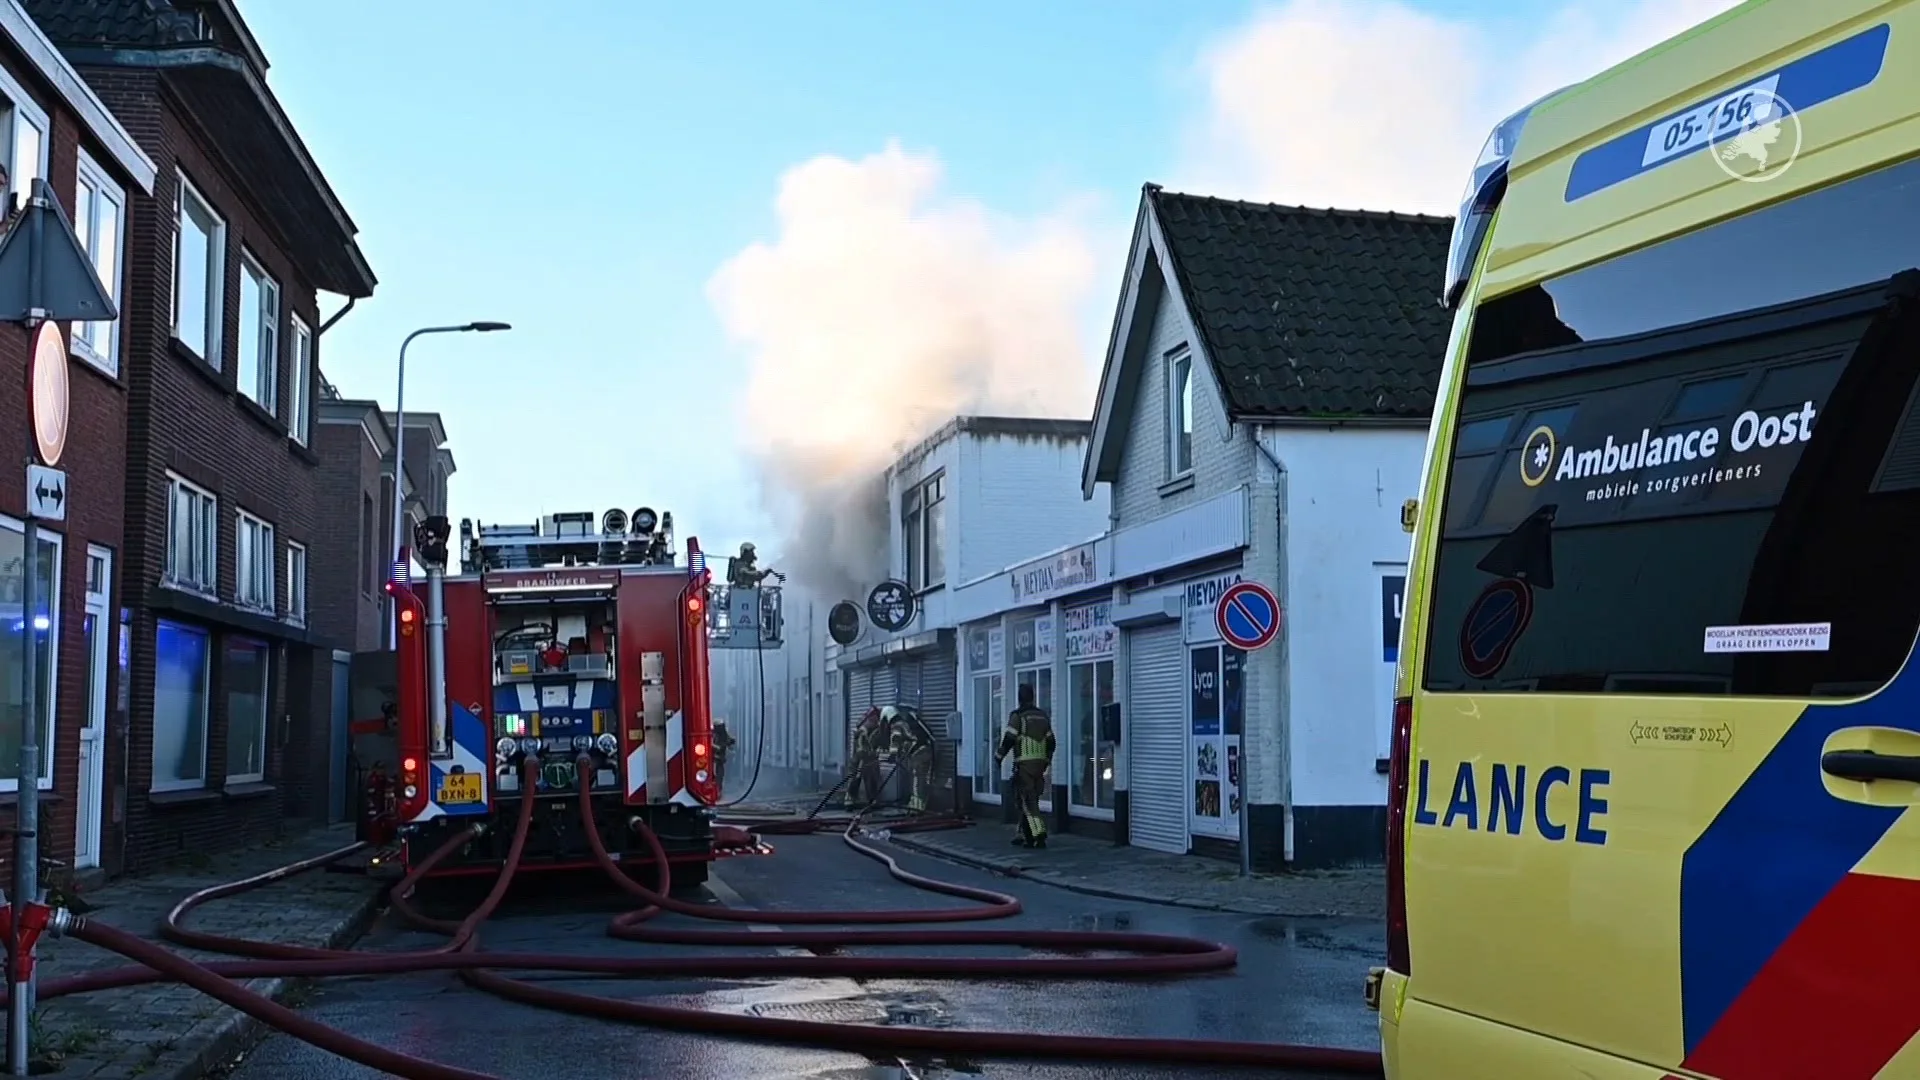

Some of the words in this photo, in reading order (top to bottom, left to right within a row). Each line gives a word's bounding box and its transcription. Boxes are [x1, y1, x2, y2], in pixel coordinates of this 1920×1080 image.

[1664, 92, 1754, 151] 05-156
[1555, 428, 1719, 481] Ambulance
[1731, 401, 1816, 452] Oost
[1586, 480, 1640, 501] mobiele
[1646, 462, 1762, 492] zorgverleners
[516, 577, 587, 588] BRANDWEER
[1716, 640, 1743, 649] GRAAG
[1746, 639, 1773, 648] EERST
[1776, 638, 1816, 648] KLOPPEN
[450, 775, 466, 787] 64
[1414, 759, 1611, 845] LANCE
